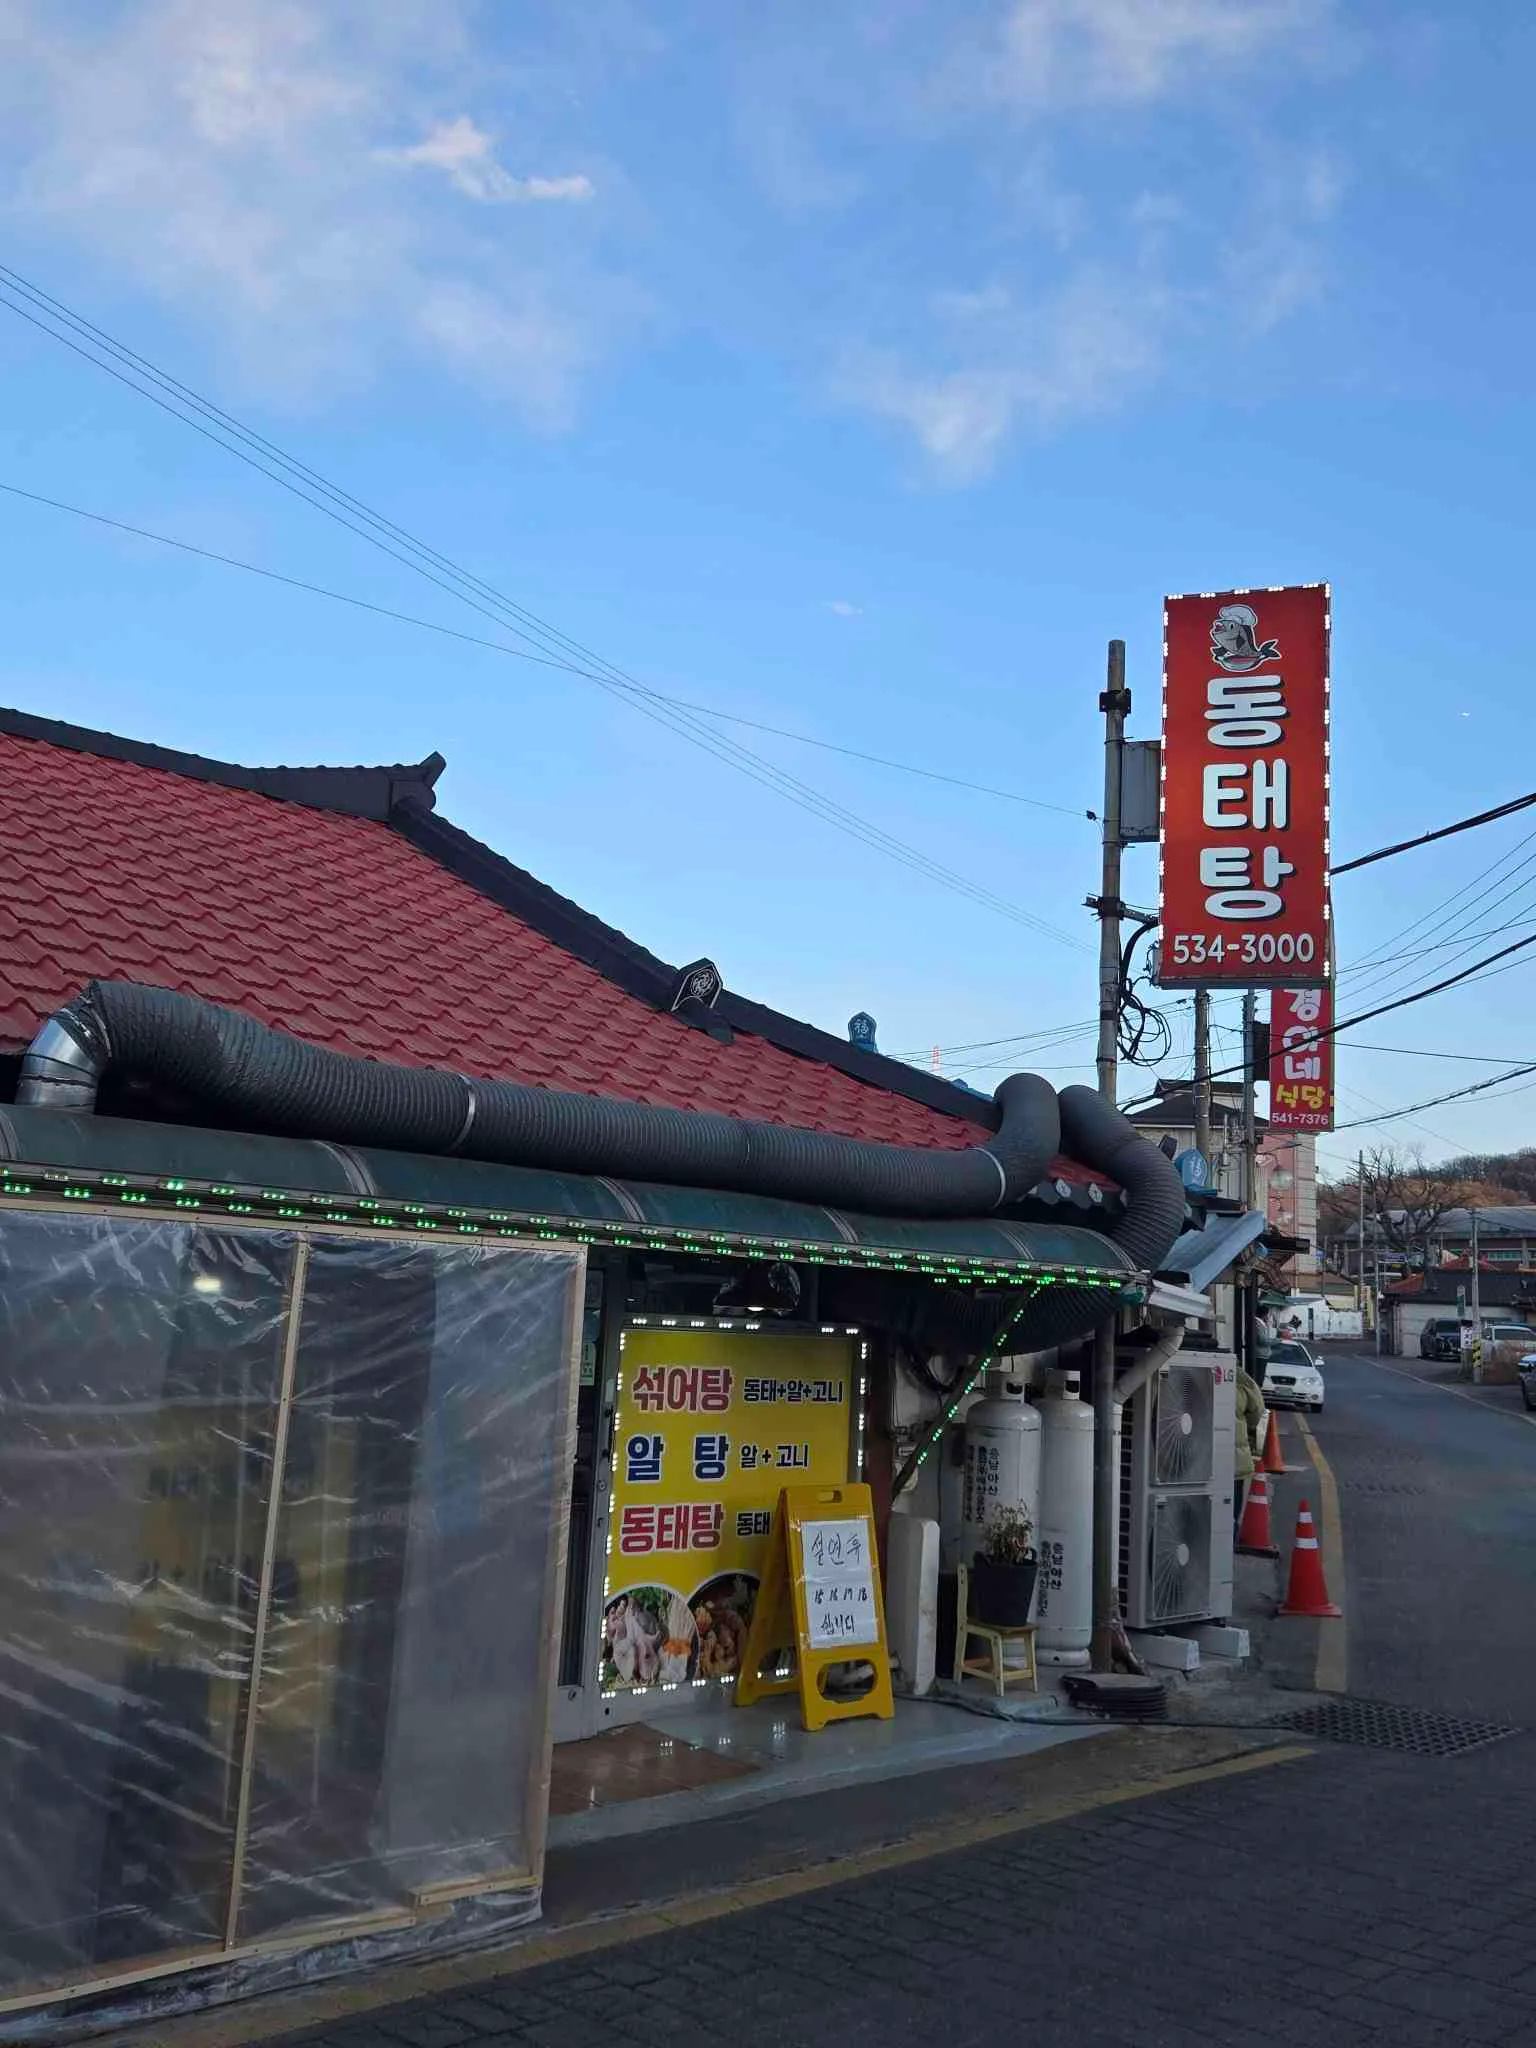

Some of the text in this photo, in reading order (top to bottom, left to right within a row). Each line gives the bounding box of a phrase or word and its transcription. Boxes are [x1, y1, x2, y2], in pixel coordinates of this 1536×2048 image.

[1199, 674, 1295, 921] 동태탕
[1172, 932, 1315, 965] 534-3000
[1275, 1083, 1326, 1110] 식당
[632, 1366, 733, 1412] 섞어탕
[1223, 1368, 1234, 1383] LG
[621, 1503, 771, 1554] 동태탕 동태
